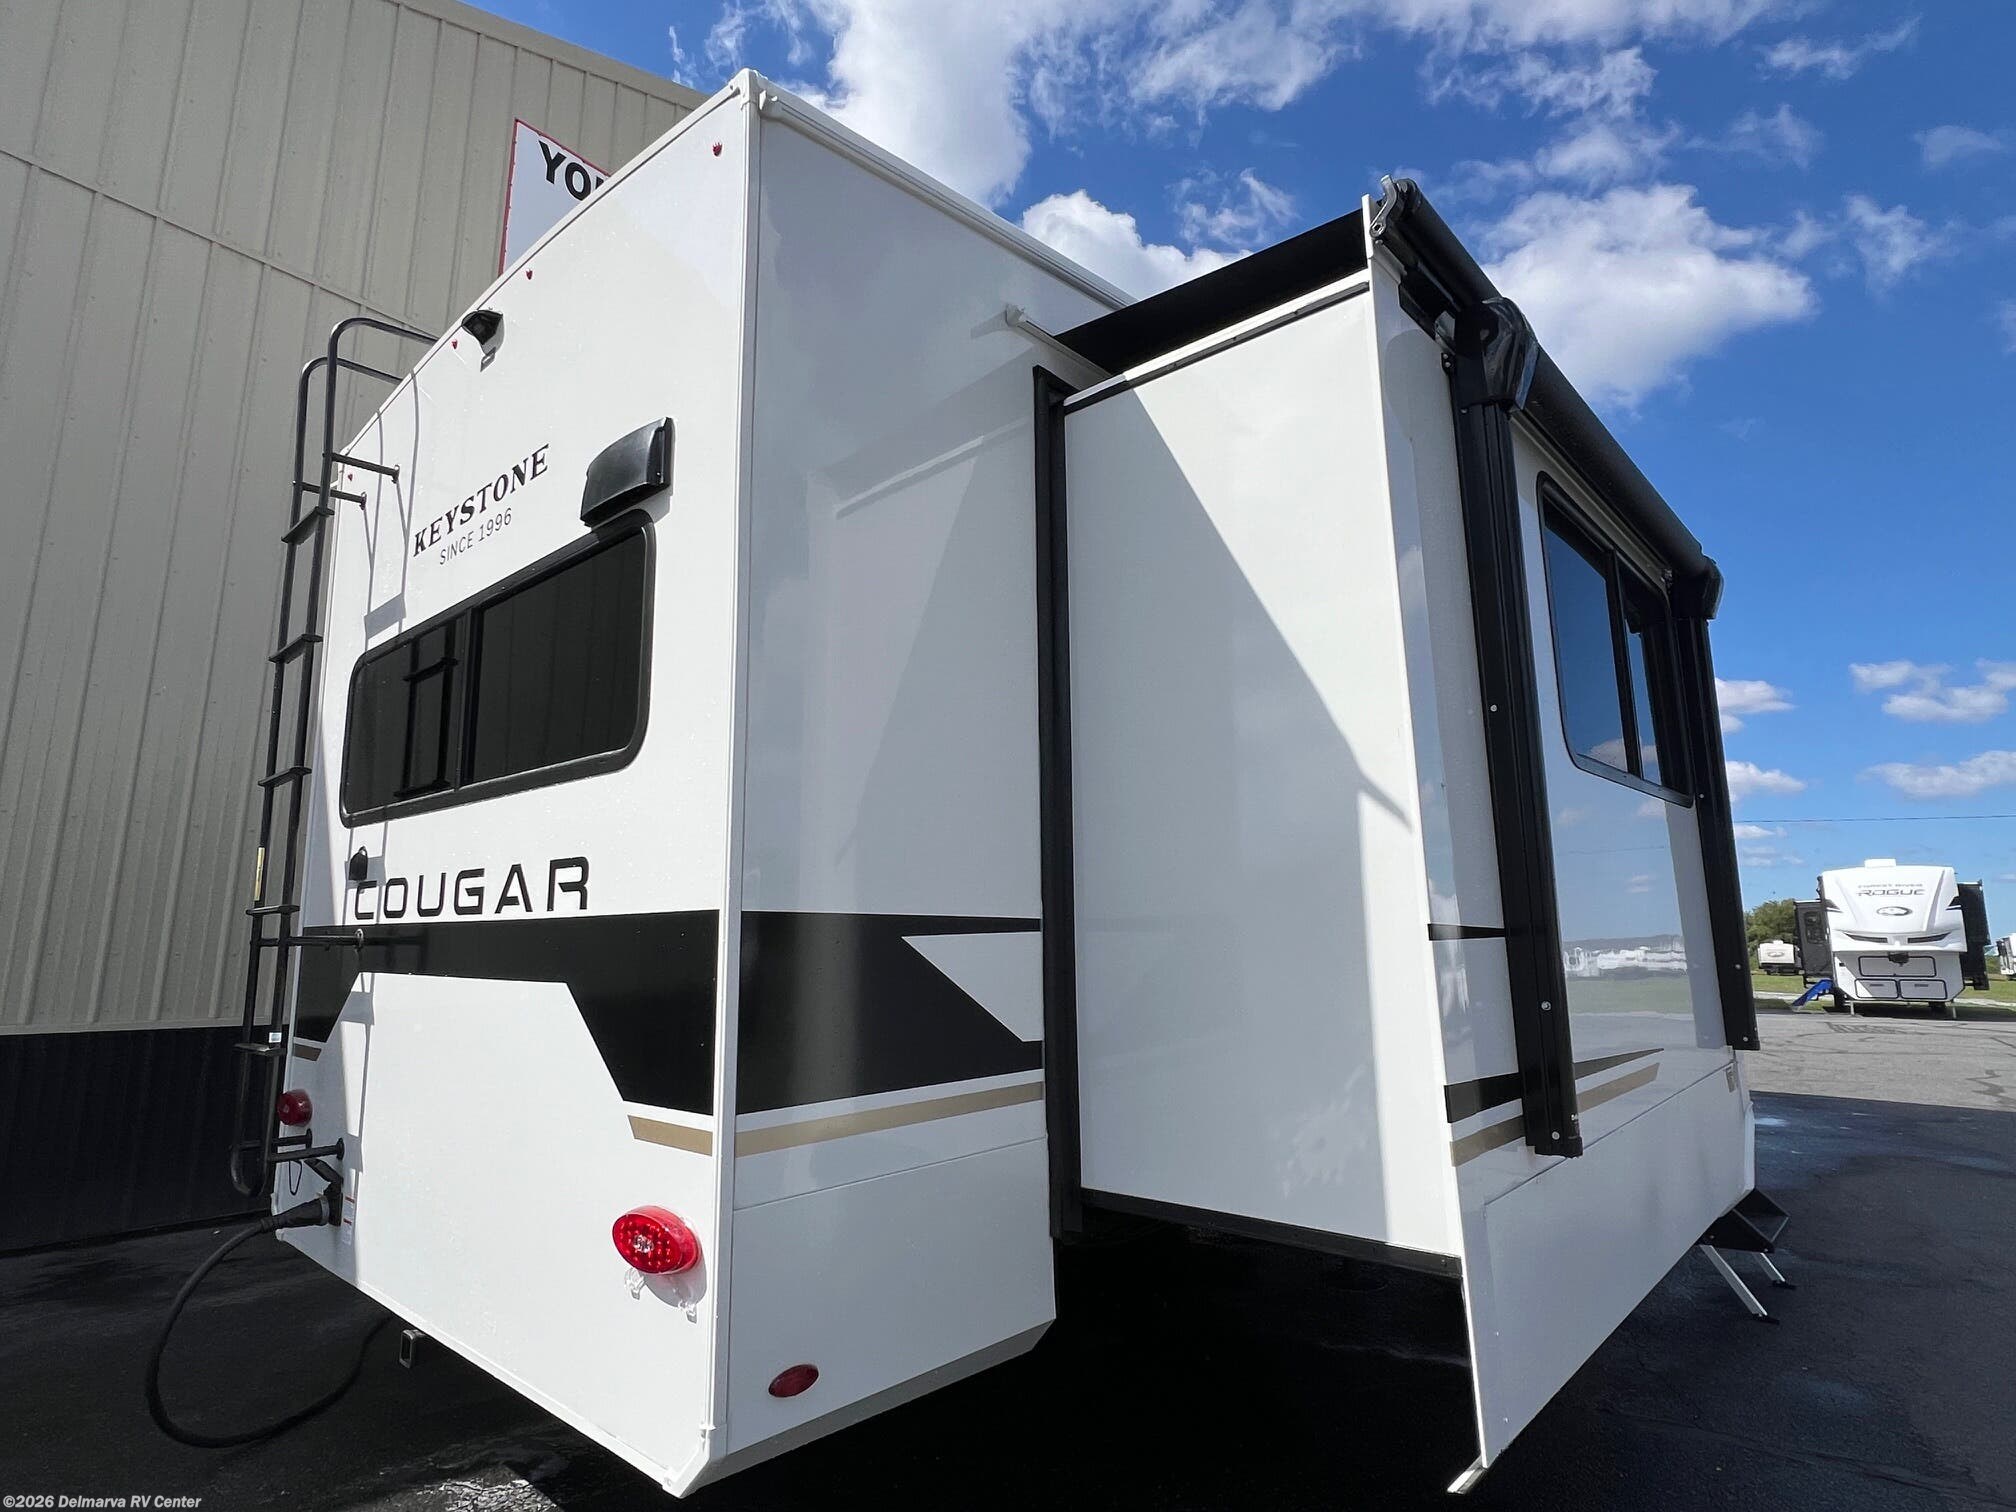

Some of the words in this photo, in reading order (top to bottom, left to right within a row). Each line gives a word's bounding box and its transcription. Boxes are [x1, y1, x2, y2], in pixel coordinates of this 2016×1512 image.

[413, 443, 549, 557] KEYSTONE
[439, 531, 474, 565] SINCE
[478, 507, 512, 542] 1996
[354, 856, 590, 920] COUGAR
